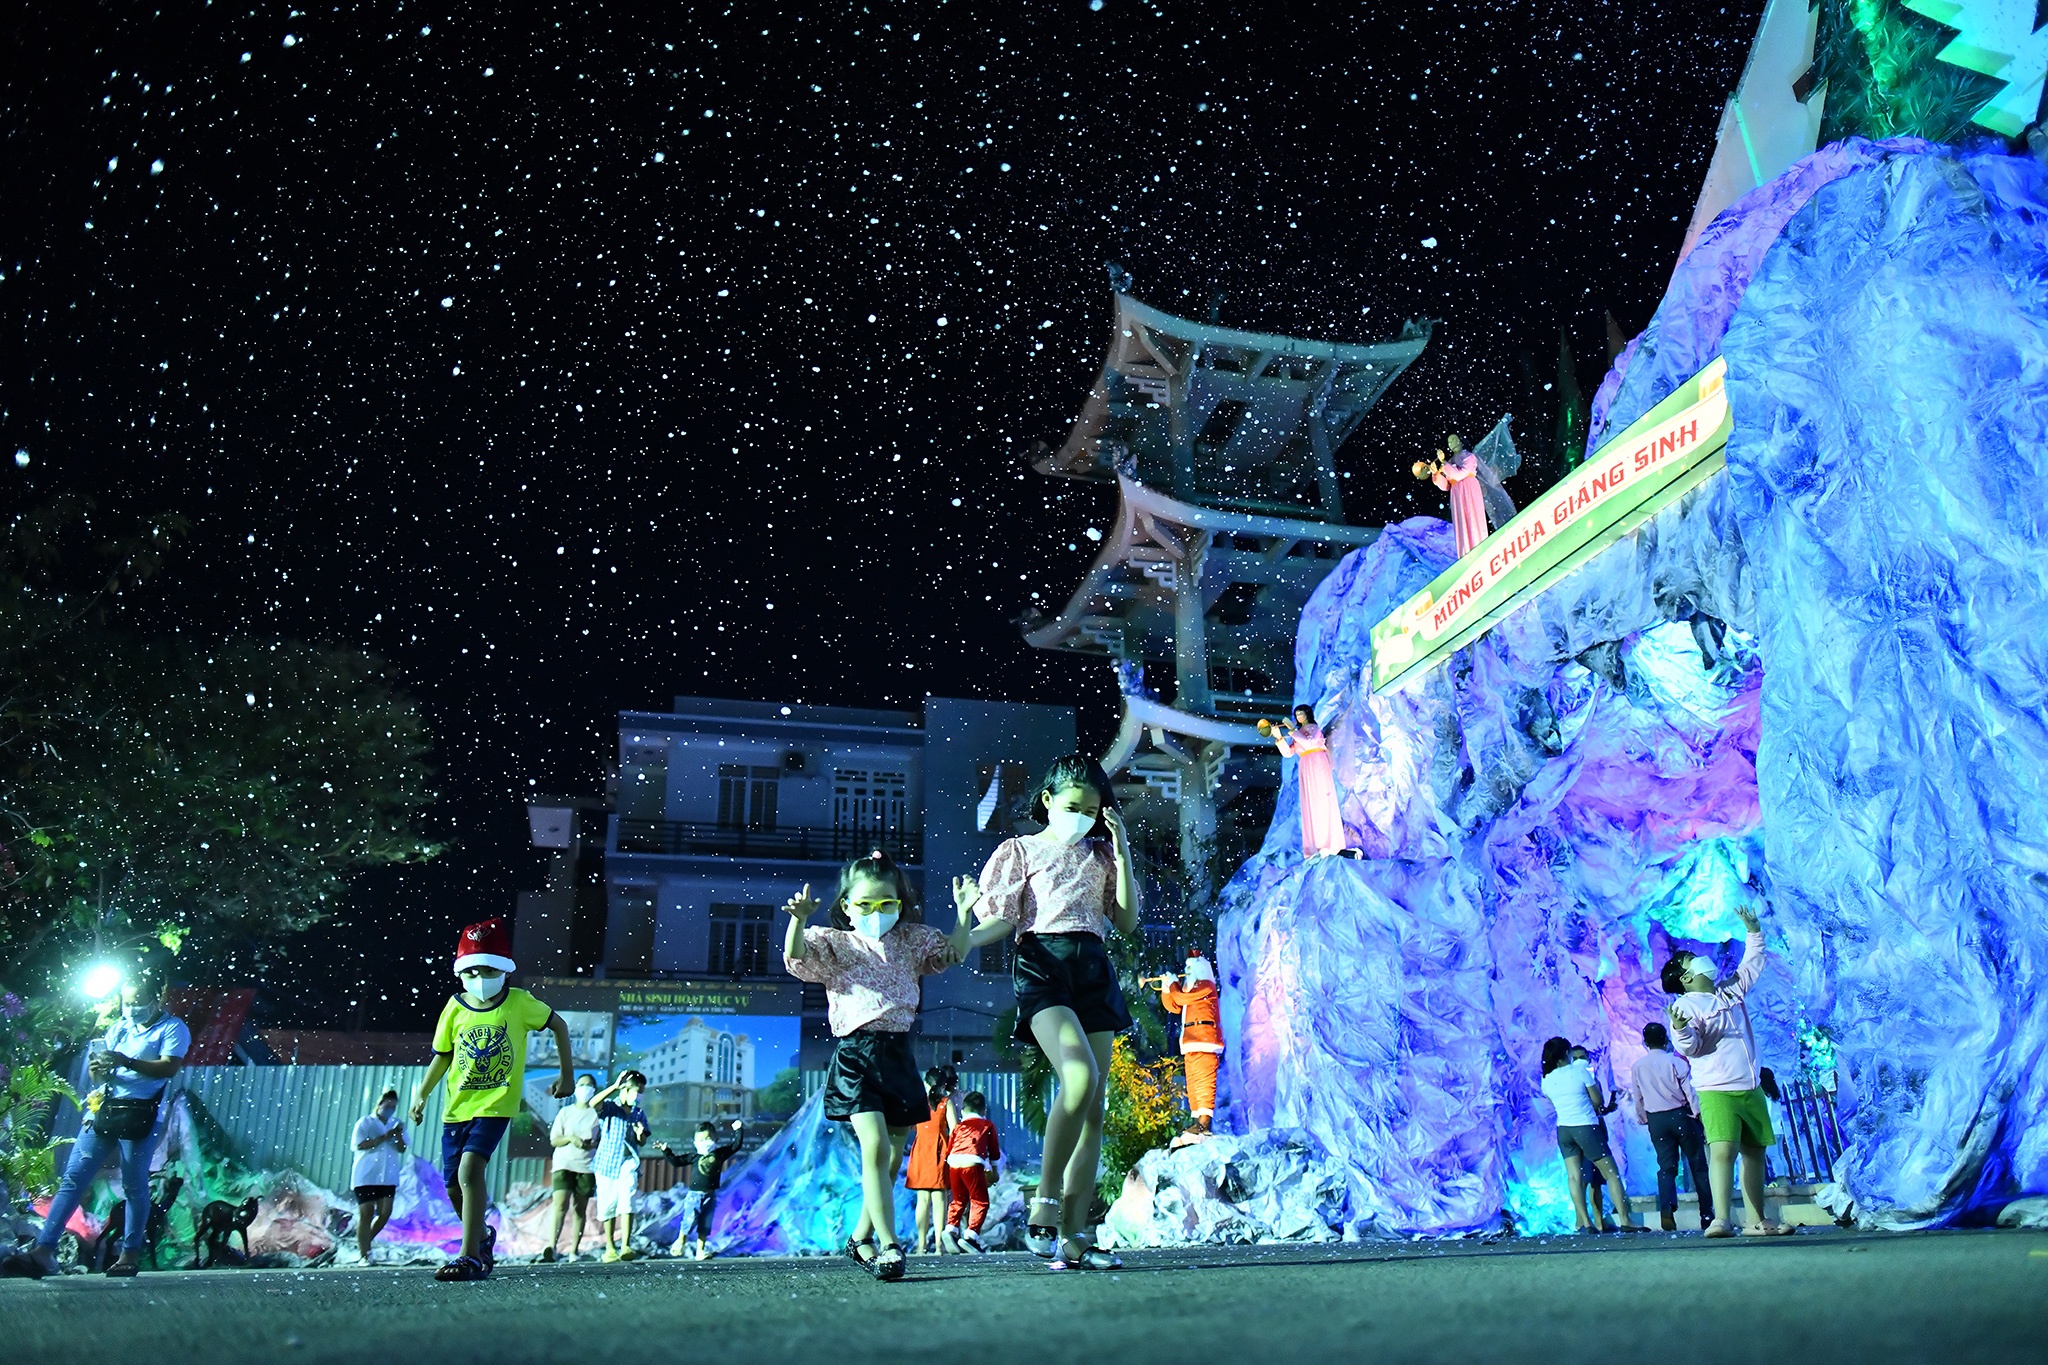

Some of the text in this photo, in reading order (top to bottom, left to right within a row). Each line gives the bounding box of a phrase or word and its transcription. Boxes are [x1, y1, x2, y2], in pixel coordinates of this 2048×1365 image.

[1434, 419, 1698, 631] MỪNG CHÚA GIÁNG SINH
[645, 993, 672, 1004] SINH
[490, 1030, 510, 1053] WLD
